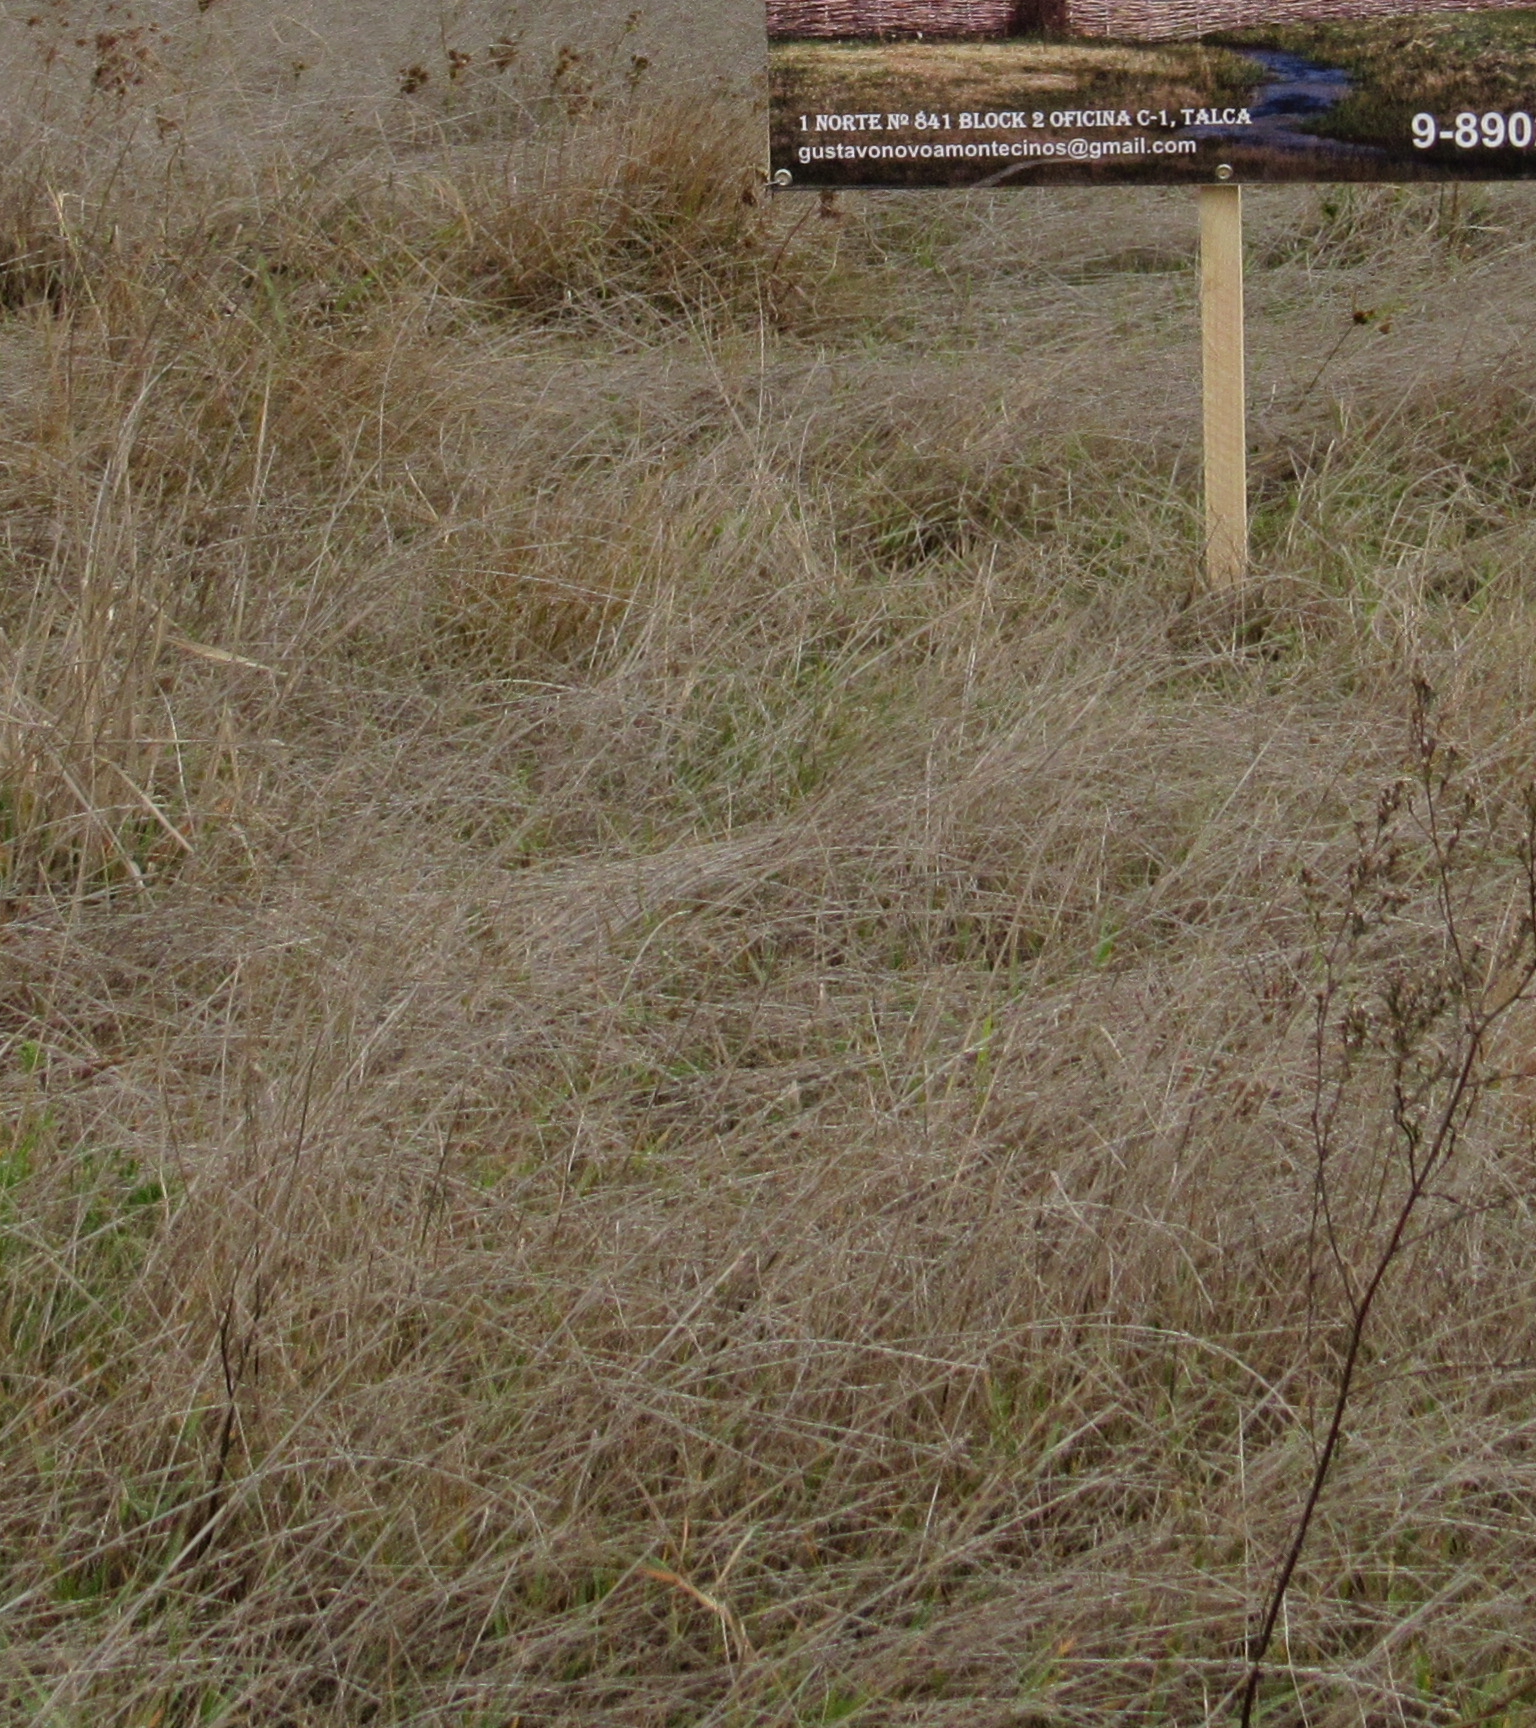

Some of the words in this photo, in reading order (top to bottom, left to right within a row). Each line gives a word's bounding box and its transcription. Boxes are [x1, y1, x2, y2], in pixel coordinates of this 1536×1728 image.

[799, 115, 809, 131] 1
[815, 113, 882, 132] NORTE
[914, 111, 952, 131] 841
[958, 111, 1028, 130] BLOCK
[1032, 112, 1045, 128] 2
[1049, 110, 1133, 127] OFICINA
[1136, 109, 1177, 128] C-1,
[1180, 107, 1253, 125] TALCA
[798, 137, 1197, 164] gustavonovoamontecinos@gmail.com
